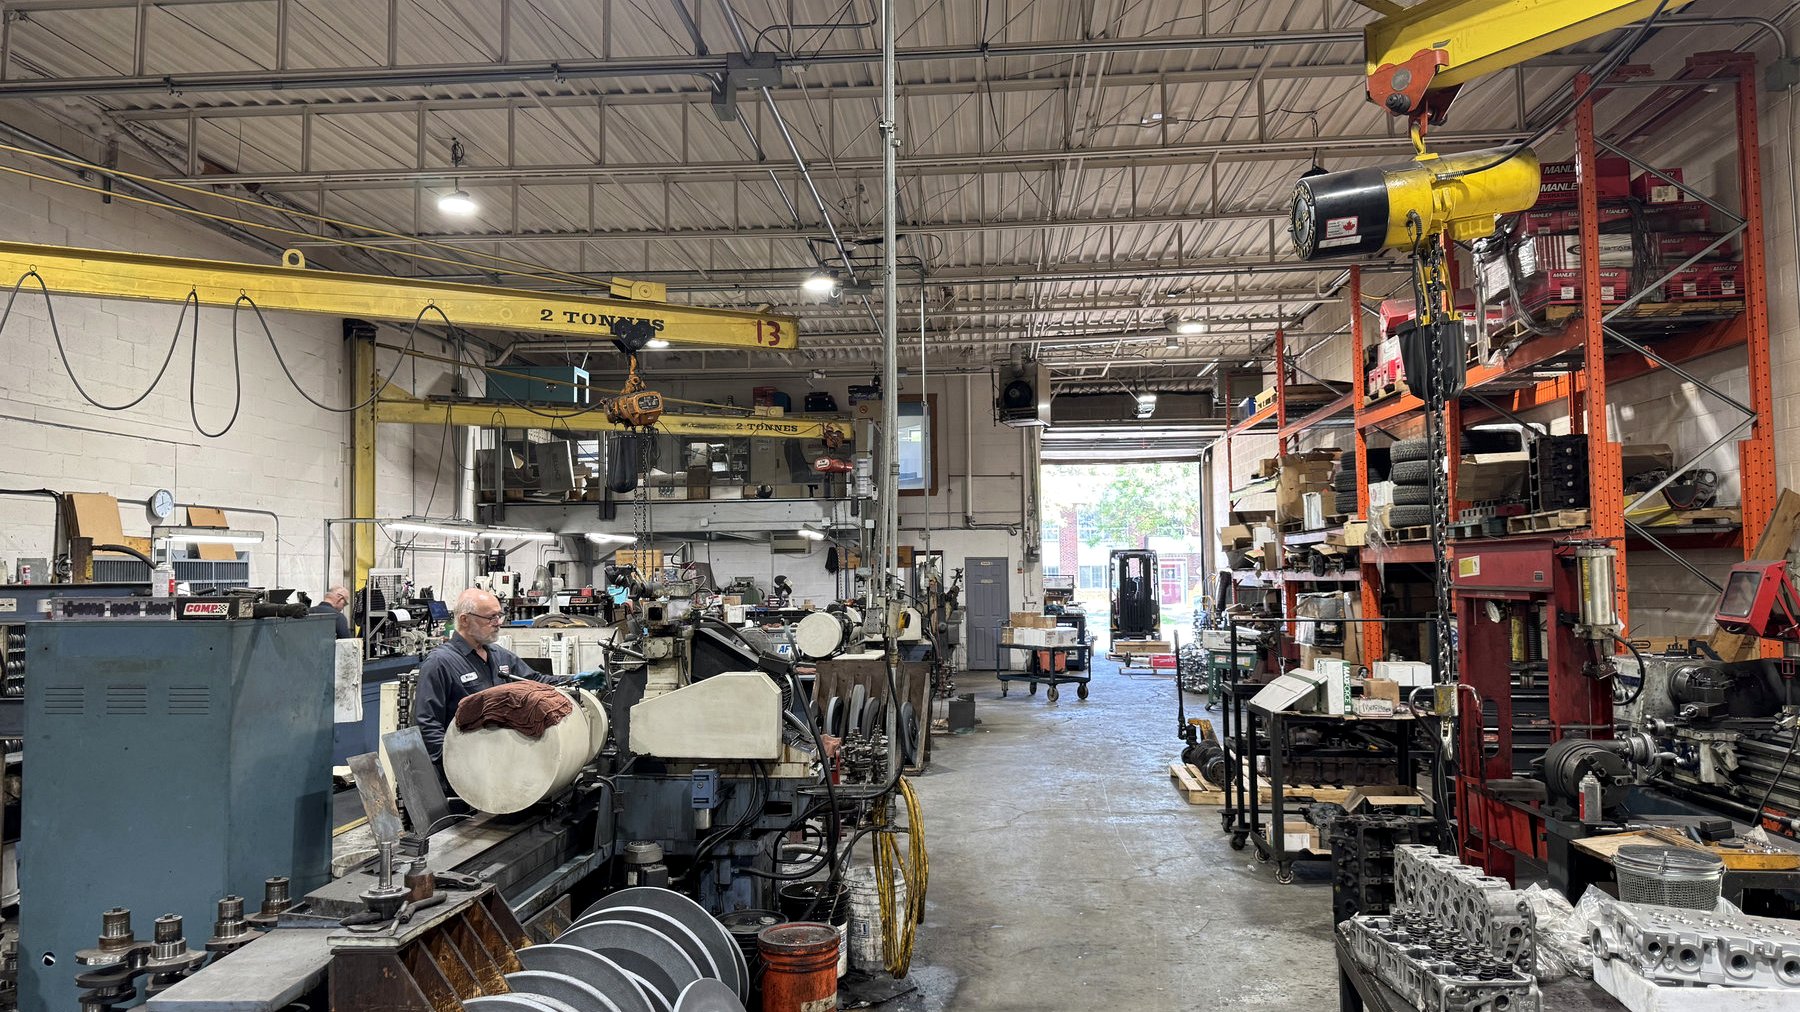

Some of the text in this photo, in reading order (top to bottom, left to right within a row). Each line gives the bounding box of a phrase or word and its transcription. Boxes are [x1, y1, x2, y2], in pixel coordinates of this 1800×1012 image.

[1541, 183, 1578, 192] MANLE
[540, 309, 553, 321] 2
[757, 319, 781, 346] 13
[736, 422, 744, 430] 2
[746, 423, 798, 432] TONNES
[186, 604, 218, 612] COMP
